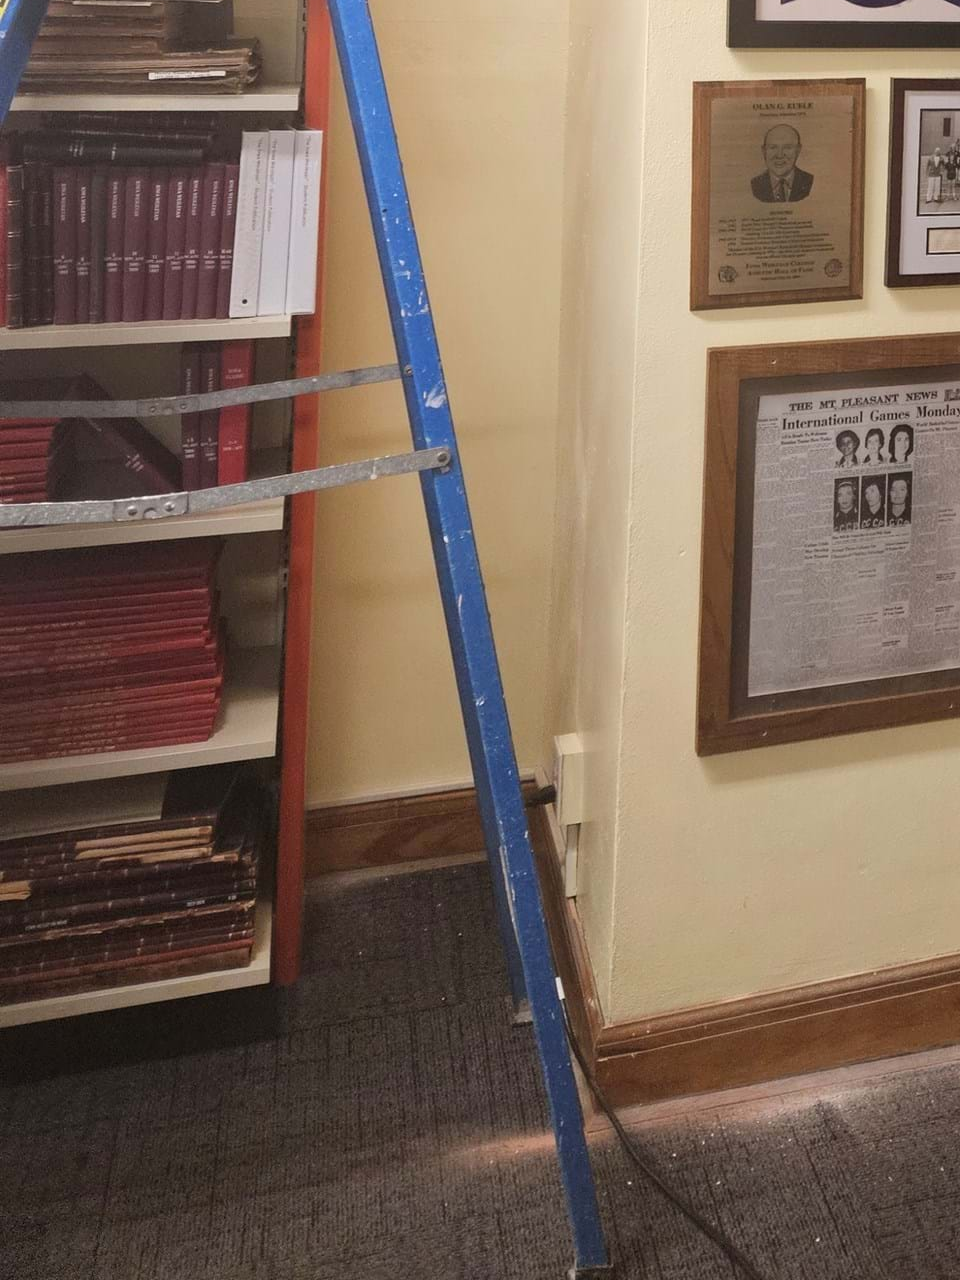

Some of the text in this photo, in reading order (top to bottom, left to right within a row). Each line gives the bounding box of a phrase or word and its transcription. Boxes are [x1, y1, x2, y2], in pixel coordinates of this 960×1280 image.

[789, 401, 813, 411] THE
[841, 393, 899, 407] PLEASANT
[905, 391, 938, 402] NEWS
[782, 411, 863, 430] International
[870, 408, 910, 423] Games
